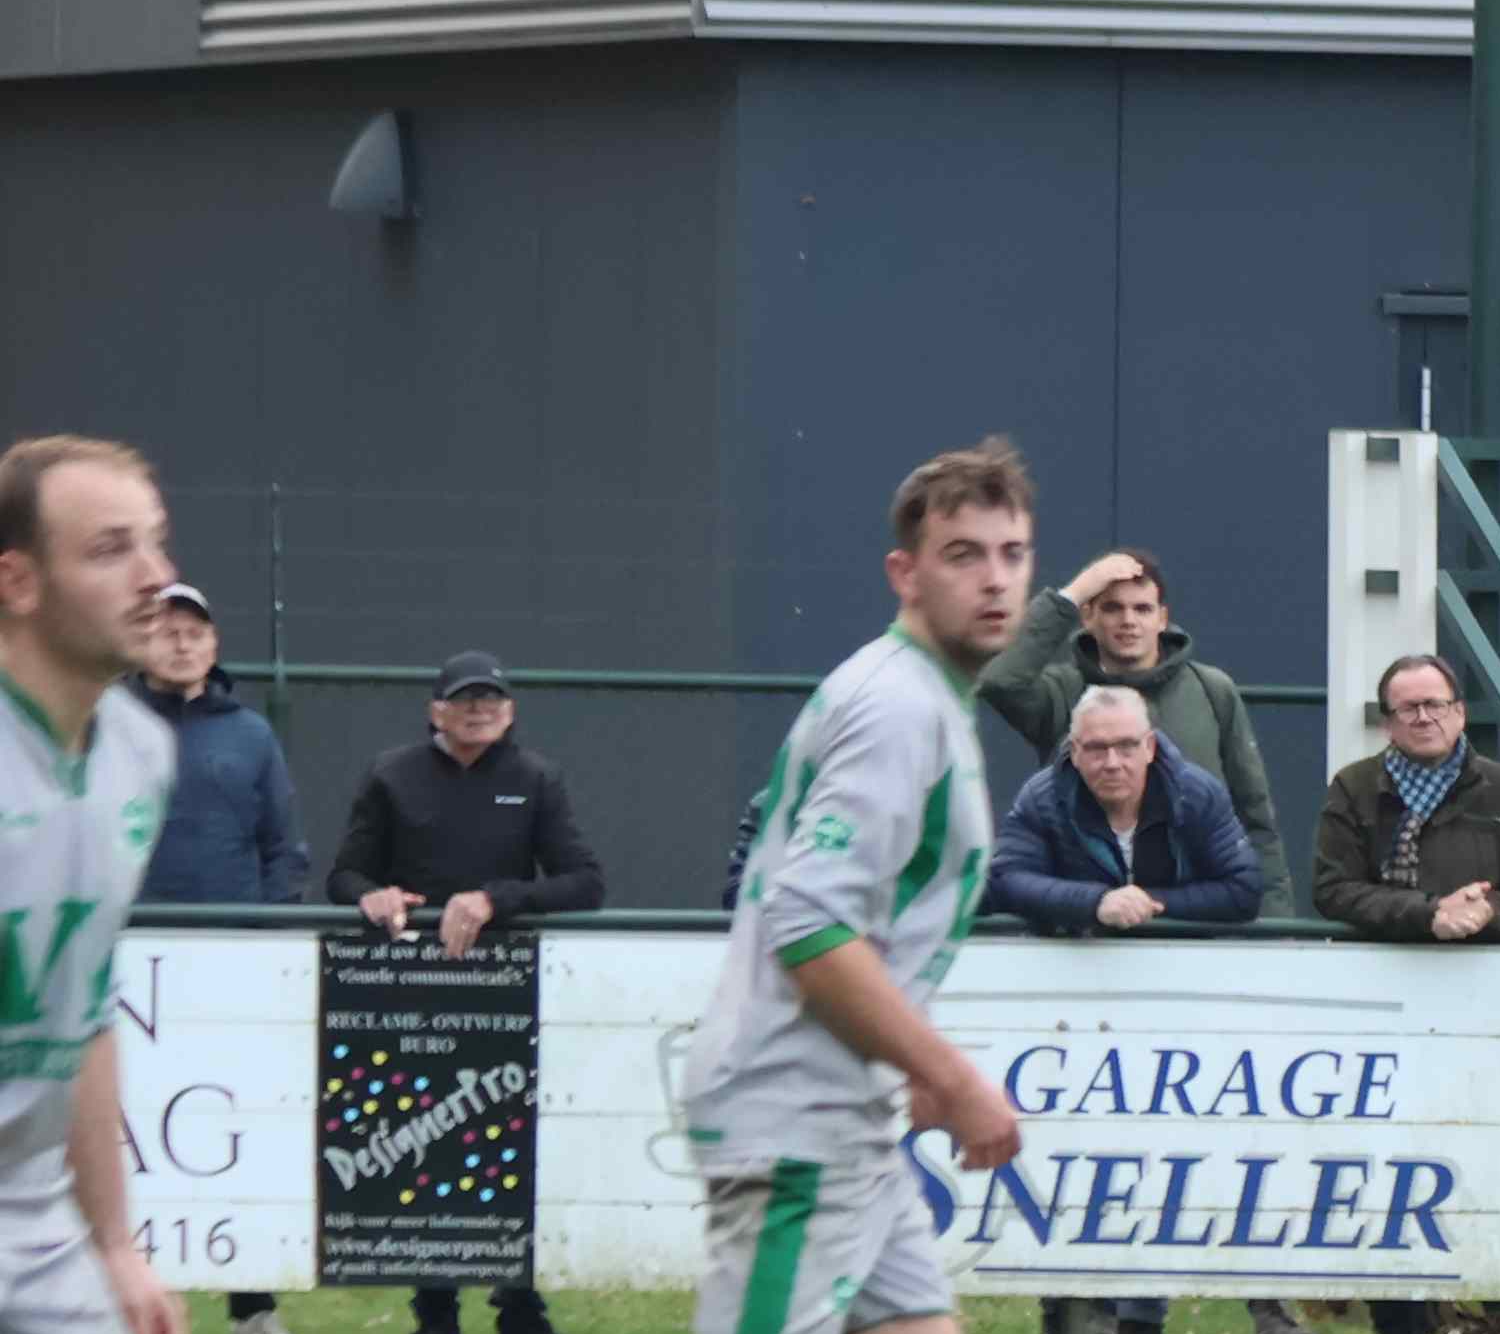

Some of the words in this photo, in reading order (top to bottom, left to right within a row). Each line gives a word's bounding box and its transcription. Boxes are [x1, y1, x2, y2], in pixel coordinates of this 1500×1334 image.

[326, 942, 367, 959] Voor
[431, 1013, 531, 1031] ONTWERP
[1005, 1045, 1400, 1120] GARAGE
